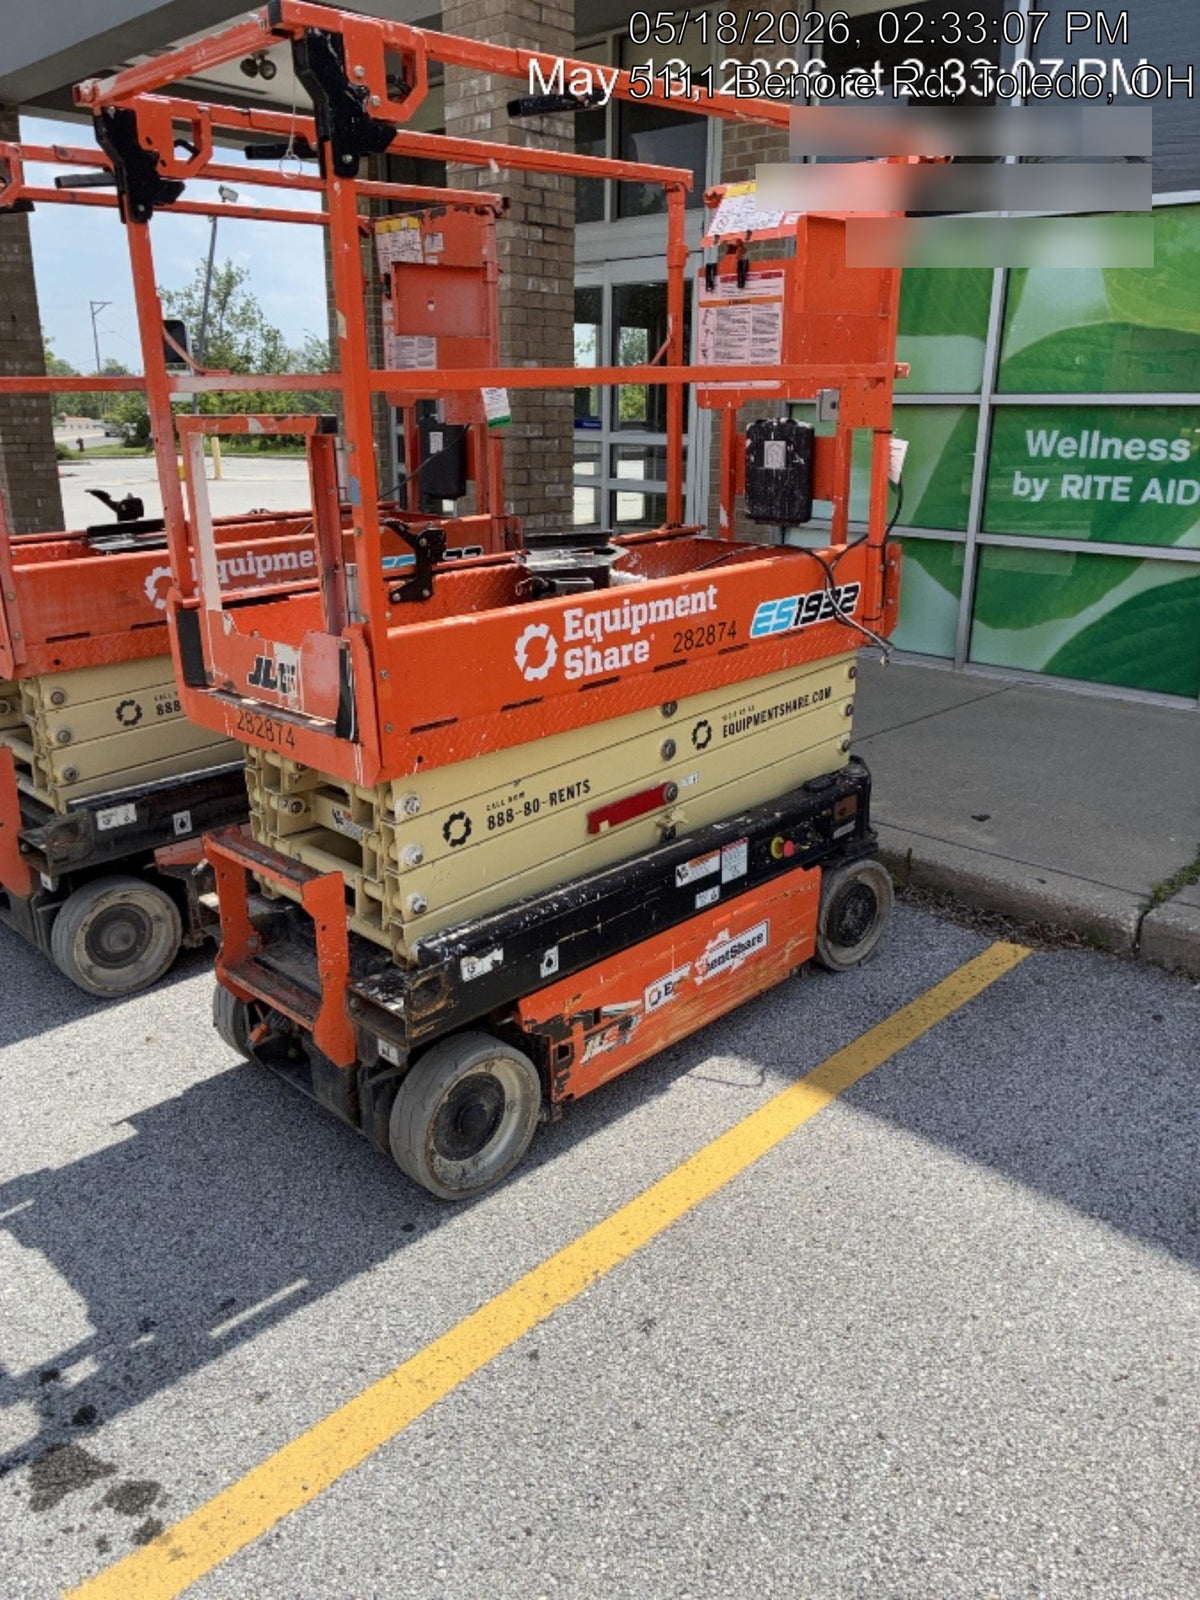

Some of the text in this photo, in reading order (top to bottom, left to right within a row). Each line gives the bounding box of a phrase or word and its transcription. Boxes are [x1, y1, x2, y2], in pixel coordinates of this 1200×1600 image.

[1026, 429, 1191, 462] Wellness
[1012, 470, 1200, 505] by RITE AID
[563, 584, 718, 642] Equipment
[673, 620, 738, 654] 282874
[564, 639, 650, 680] Share
[237, 712, 296, 748] 282874
[723, 686, 832, 738] EQUIPMENTSHARE.COM
[487, 779, 591, 831] 888-80-RENTS
